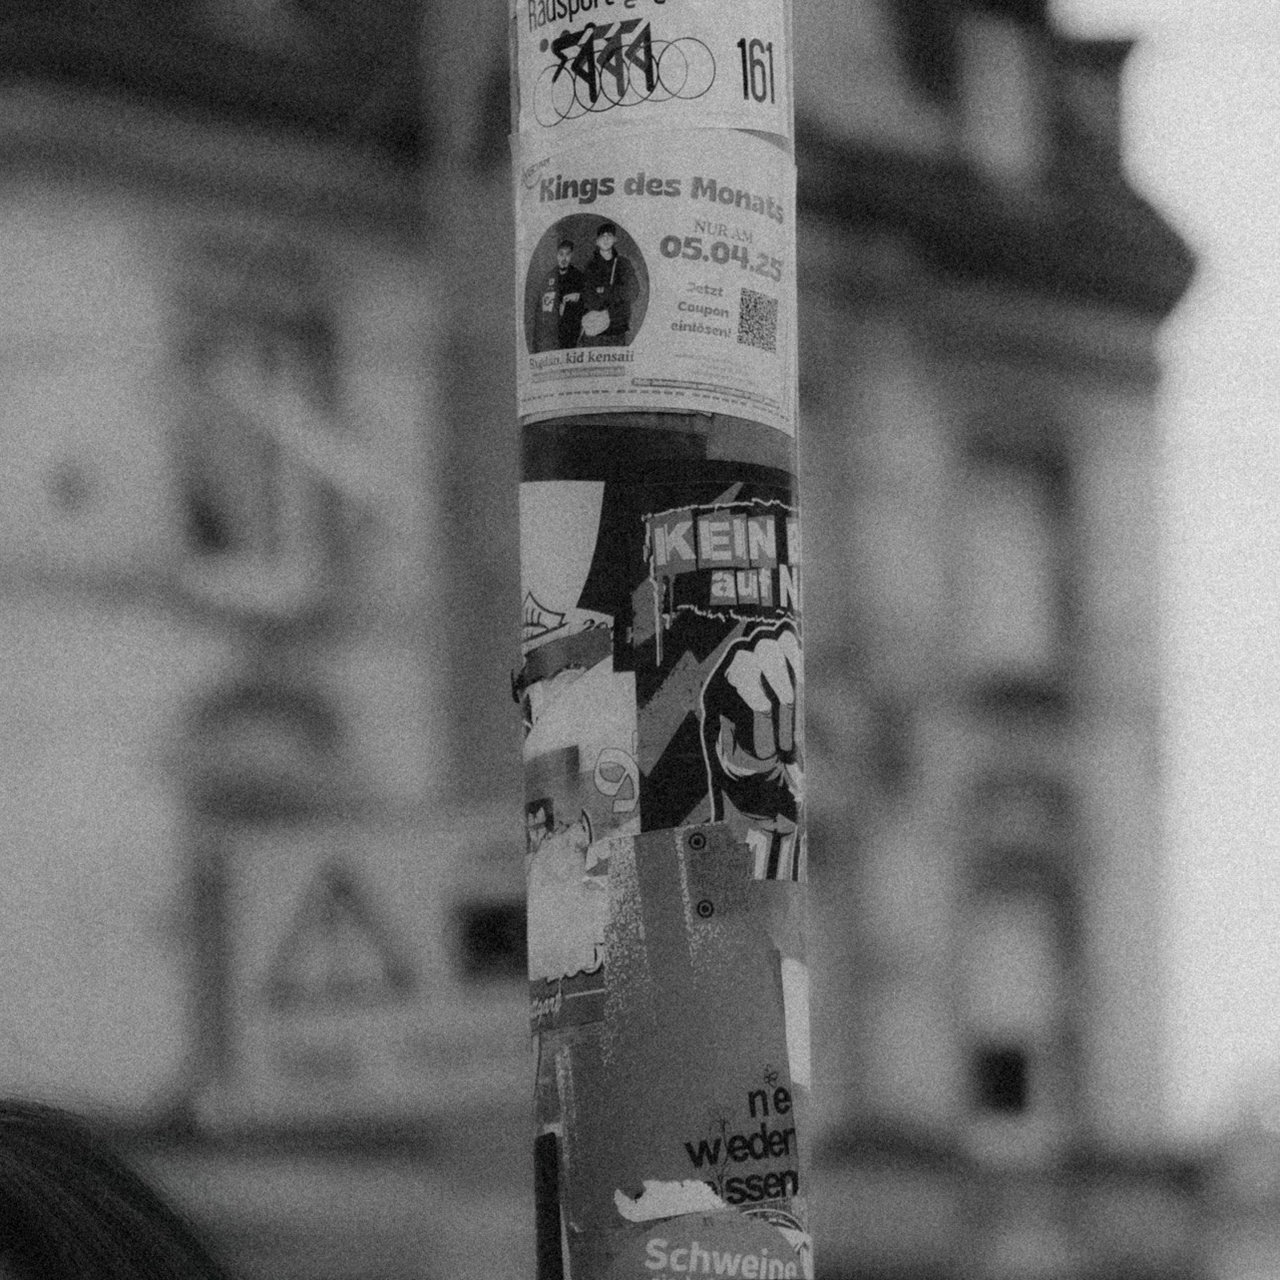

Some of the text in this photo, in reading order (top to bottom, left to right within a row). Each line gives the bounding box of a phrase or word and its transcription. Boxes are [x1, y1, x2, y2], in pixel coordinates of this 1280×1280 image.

[736, 37, 775, 104] 161
[538, 172, 785, 225] Kings des Monats
[694, 219, 729, 239] NUR
[659, 235, 785, 282] 05.04.25
[677, 300, 730, 319] Coupon
[669, 319, 732, 339] einlösen!
[565, 350, 585, 365] kid
[654, 518, 777, 566] KEIN
[710, 567, 772, 599] auf
[644, 1237, 798, 1280] Schweine
